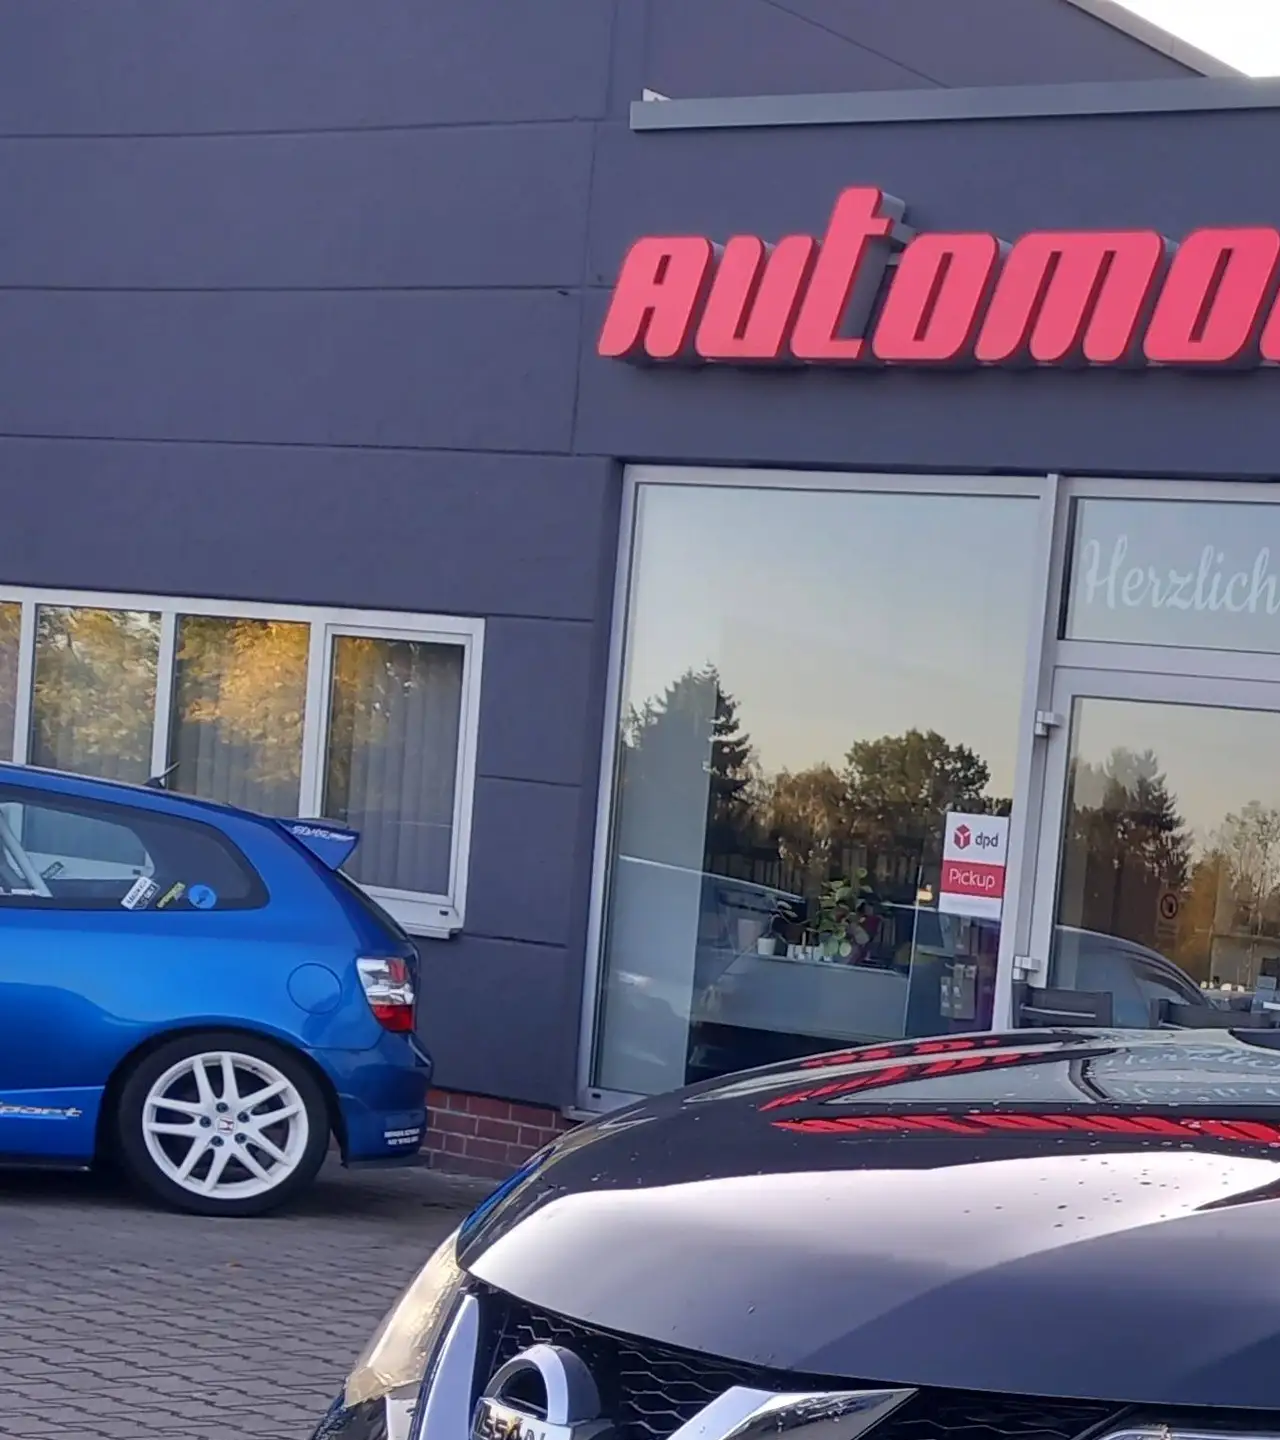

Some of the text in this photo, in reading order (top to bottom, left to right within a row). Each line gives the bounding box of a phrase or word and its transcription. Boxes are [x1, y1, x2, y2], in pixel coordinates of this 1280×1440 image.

[974, 831, 1000, 850] dpd
[948, 867, 996, 892] Pickup
[0, 1101, 83, 1118] port
